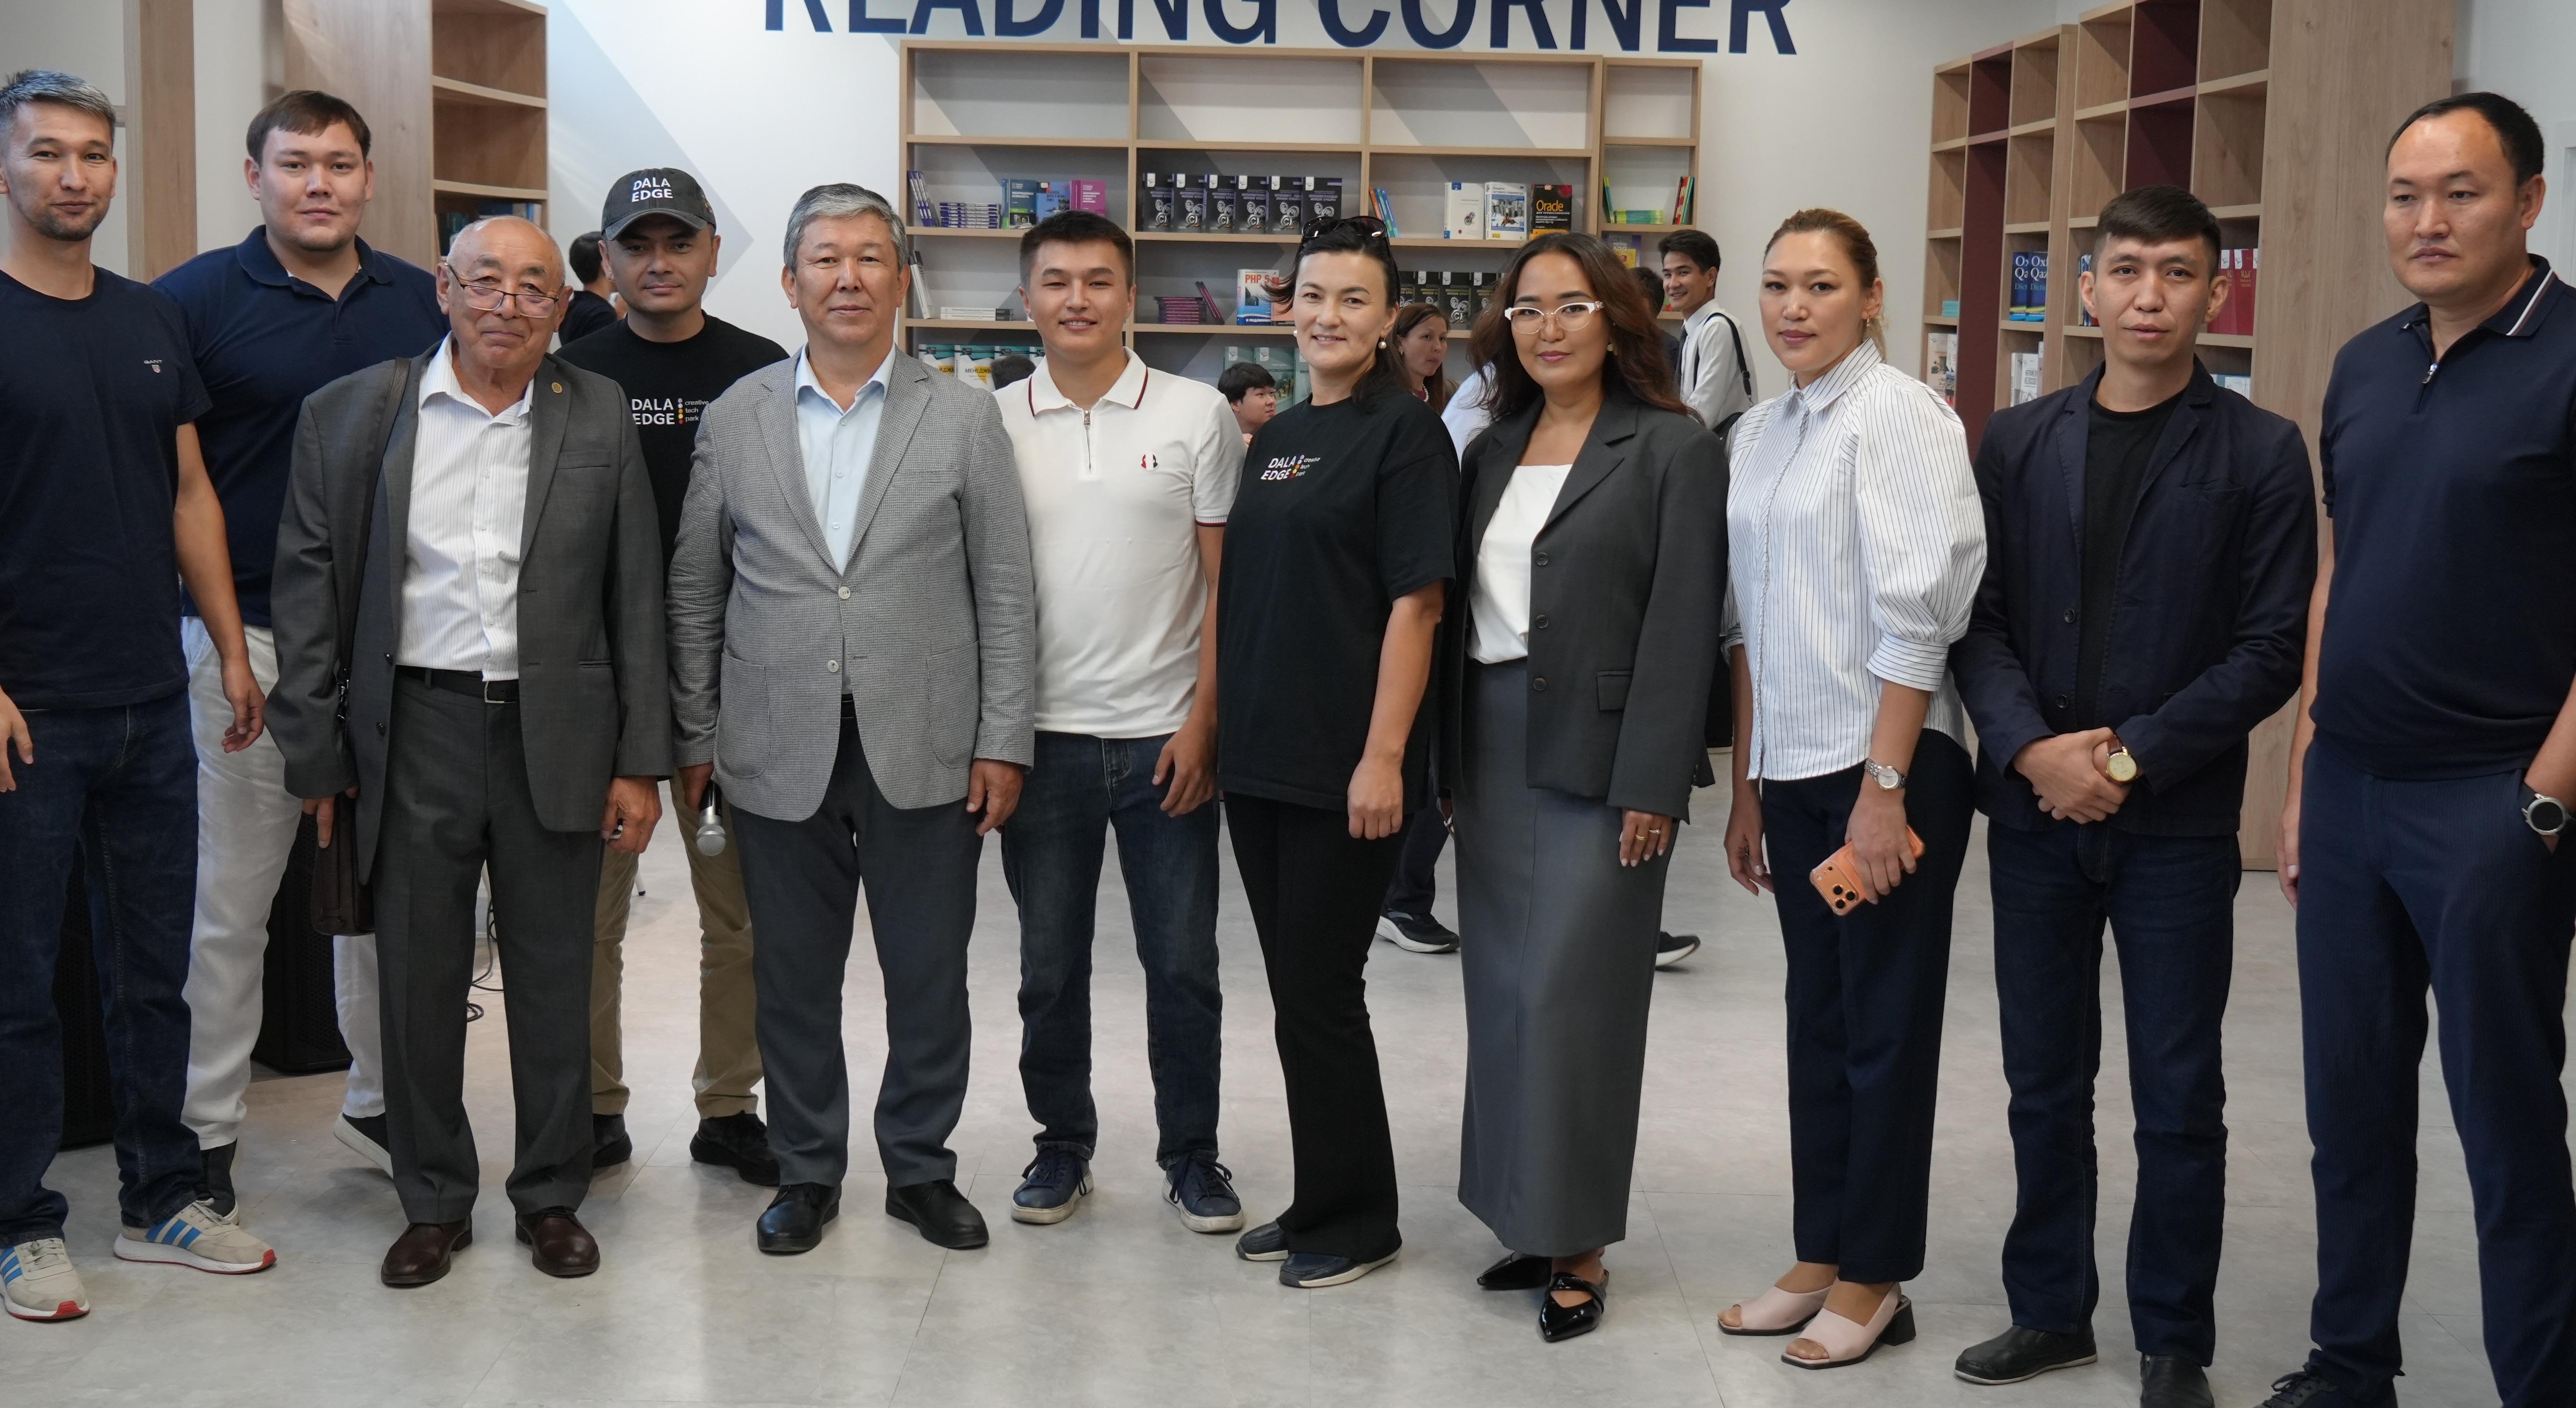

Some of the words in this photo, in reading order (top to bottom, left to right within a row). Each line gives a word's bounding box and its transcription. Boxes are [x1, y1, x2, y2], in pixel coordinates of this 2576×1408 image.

[633, 177, 671, 191] DALA
[631, 188, 673, 202] EDGE
[1536, 200, 1564, 212] Oracle
[1245, 274, 1261, 284] PHP
[632, 398, 674, 411] DALA
[633, 413, 675, 425] EDGE
[1268, 455, 1297, 469] DALA
[1260, 469, 1292, 480] EDGE
